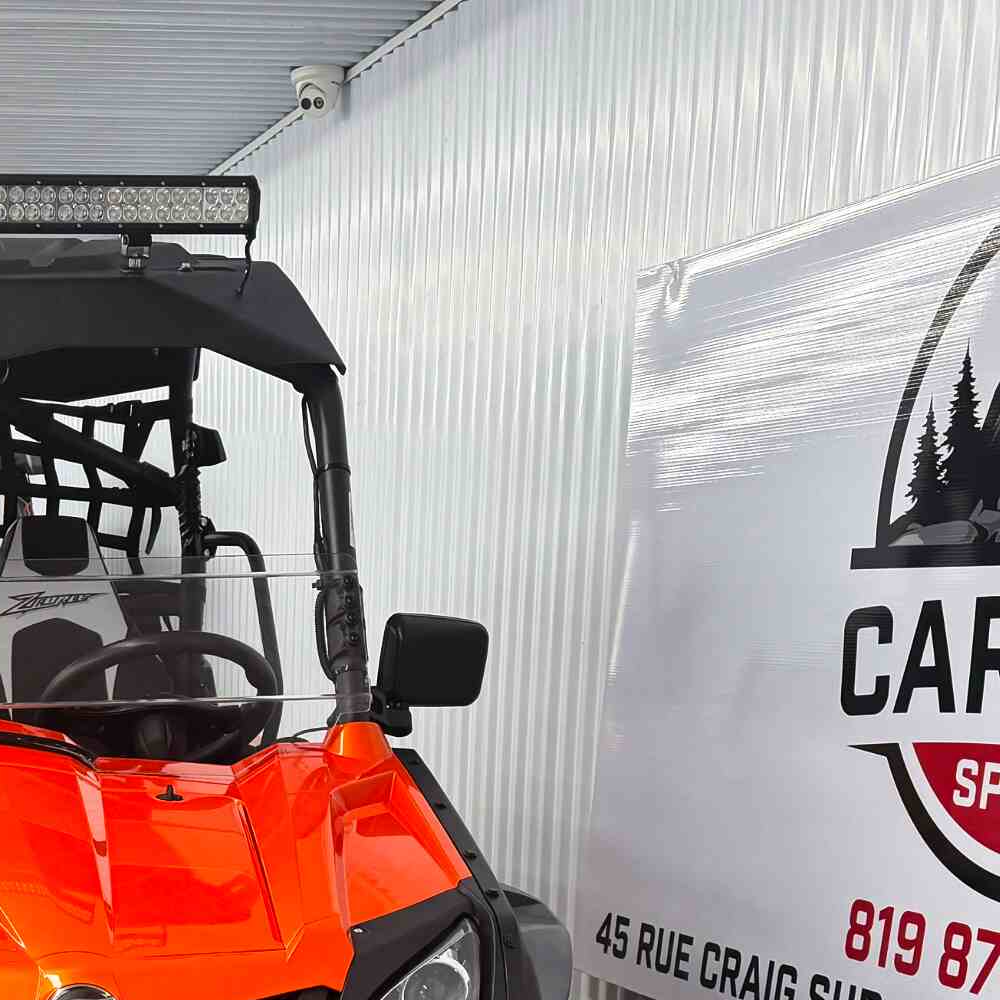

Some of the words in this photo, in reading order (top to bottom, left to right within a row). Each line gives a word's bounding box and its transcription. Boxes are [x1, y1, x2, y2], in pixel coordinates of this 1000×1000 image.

[952, 758, 1000, 810] SP
[595, 912, 630, 960] 45
[636, 922, 694, 981] RUE
[844, 898, 926, 977] 819
[938, 921, 1000, 995] 87
